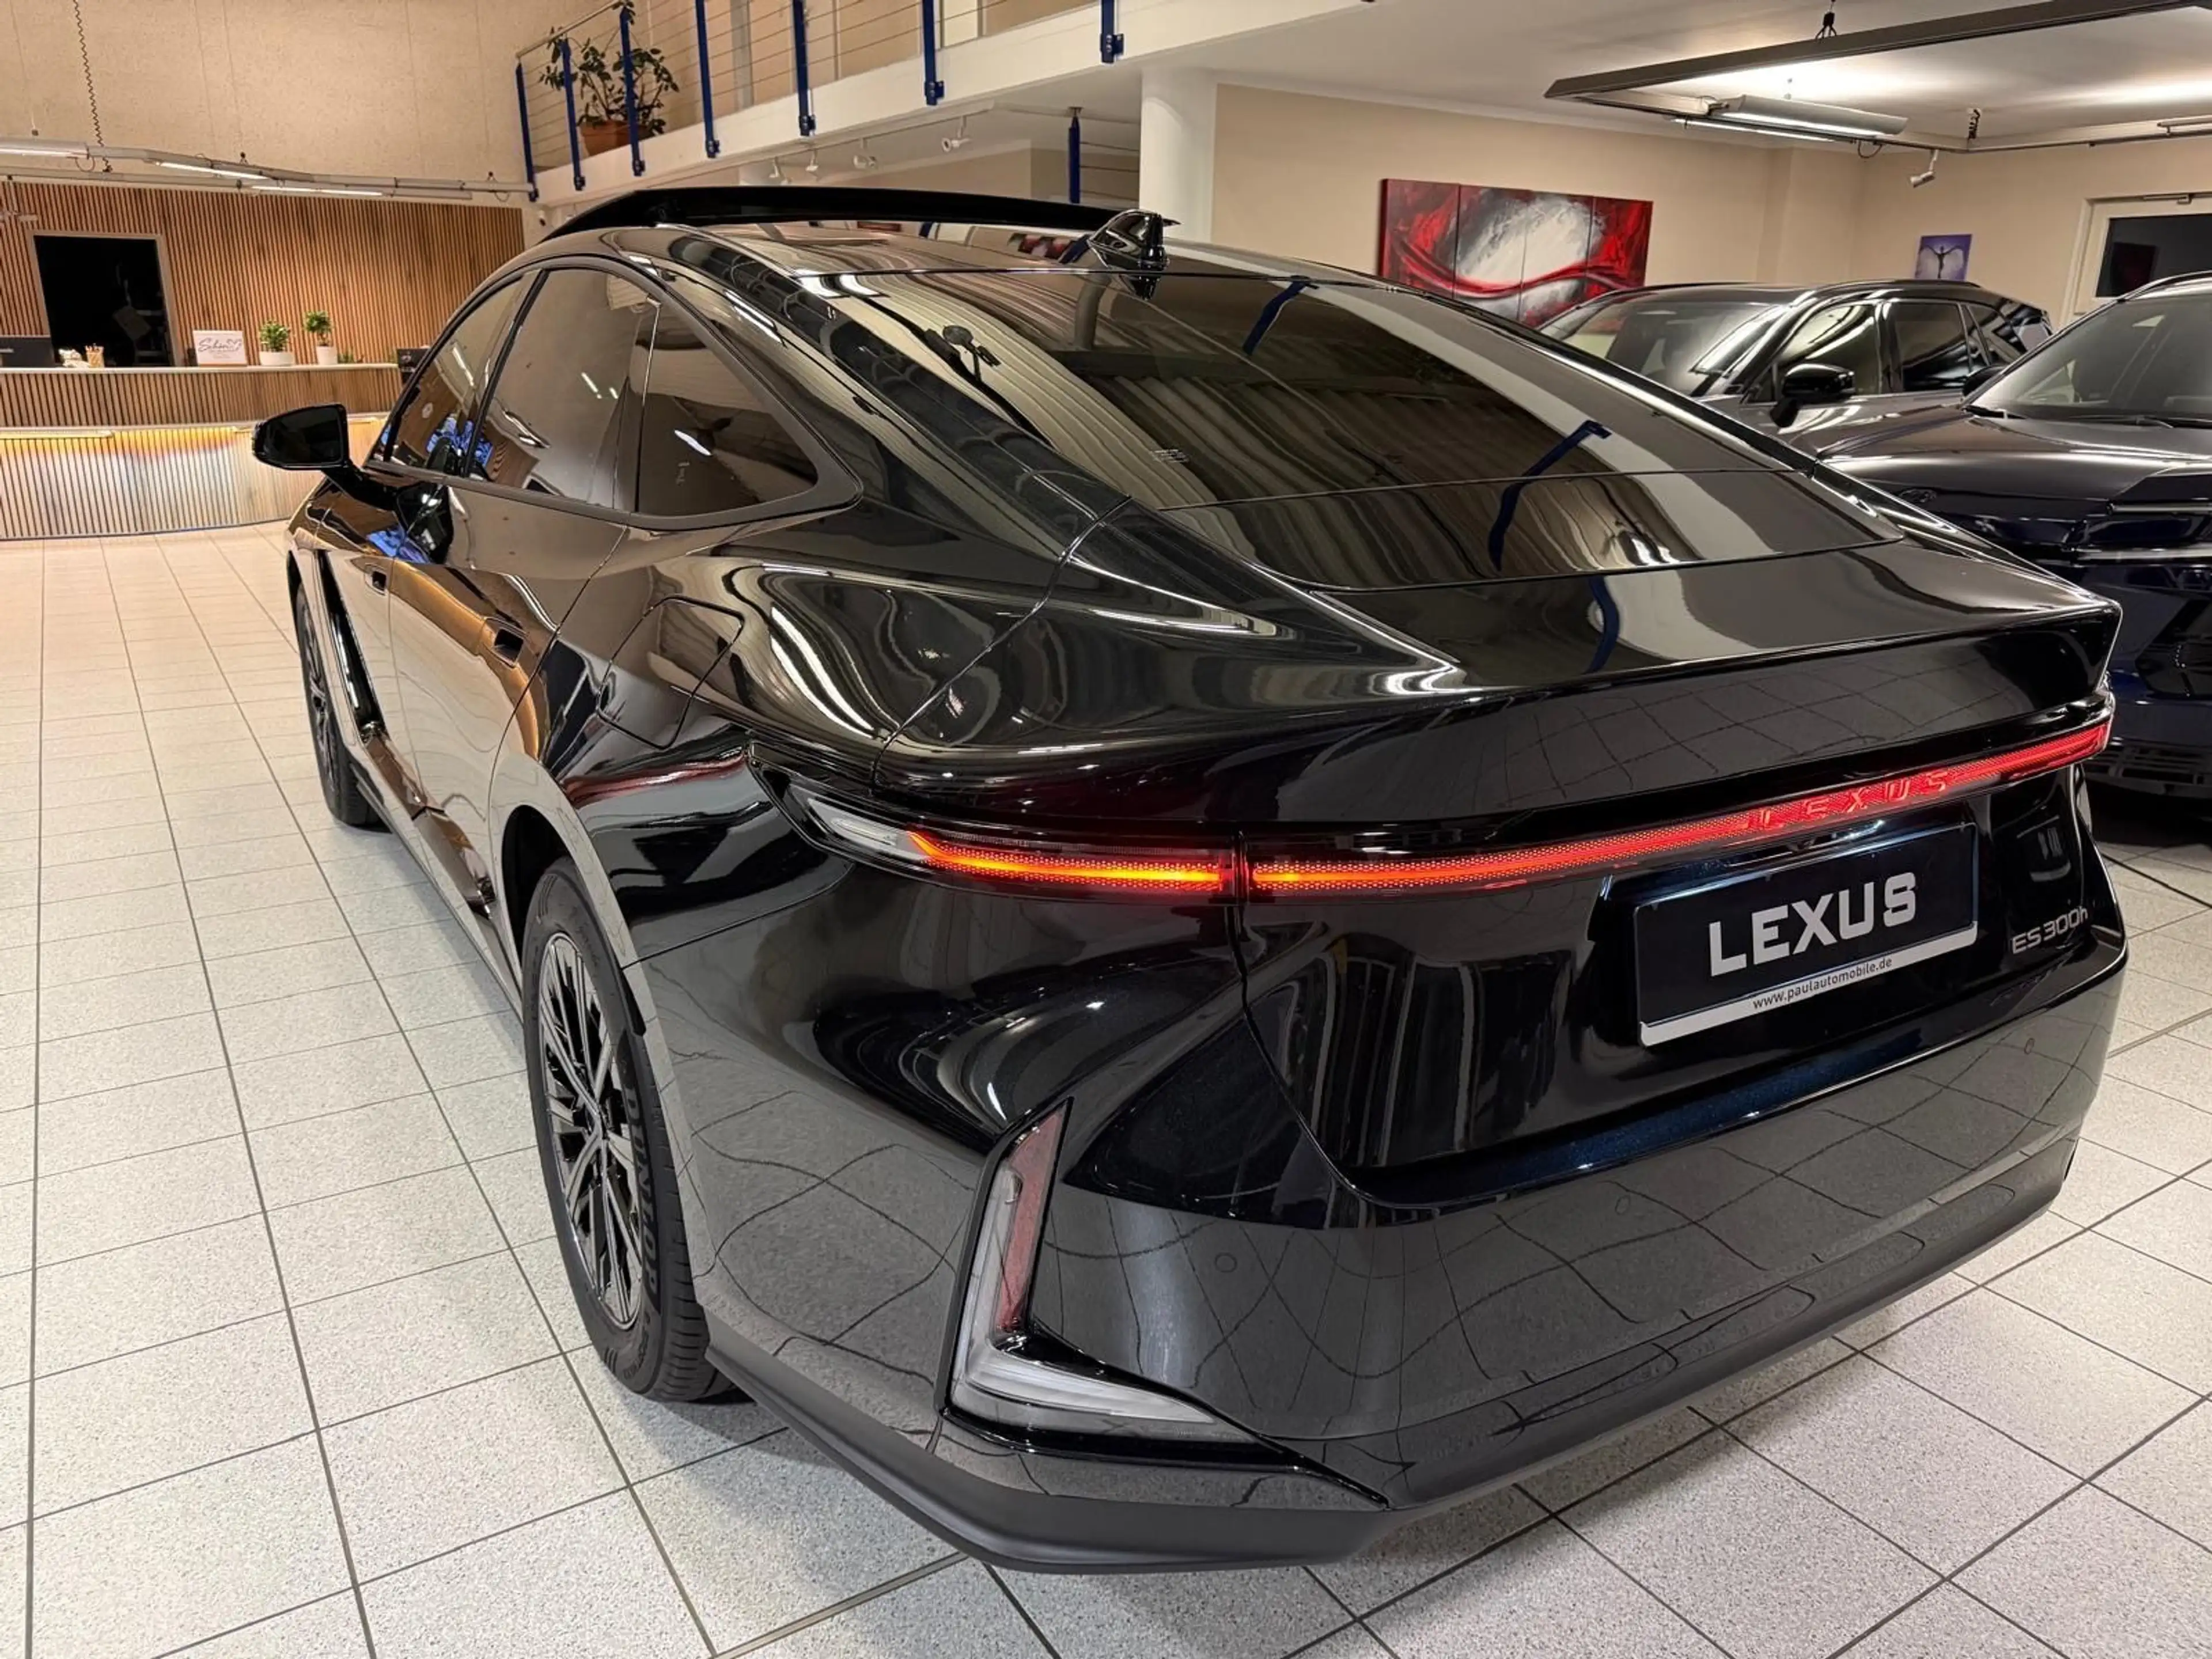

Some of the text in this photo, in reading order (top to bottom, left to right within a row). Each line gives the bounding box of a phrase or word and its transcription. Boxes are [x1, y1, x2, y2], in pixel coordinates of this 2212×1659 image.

[1760, 771, 1948, 827] LEXUS
[1709, 872, 1916, 976] LEXUS
[2013, 906, 2088, 954] ES 300h
[1753, 956, 1893, 1009] www.paulautomobile.de
[625, 1086, 658, 1294] DUNLOP
